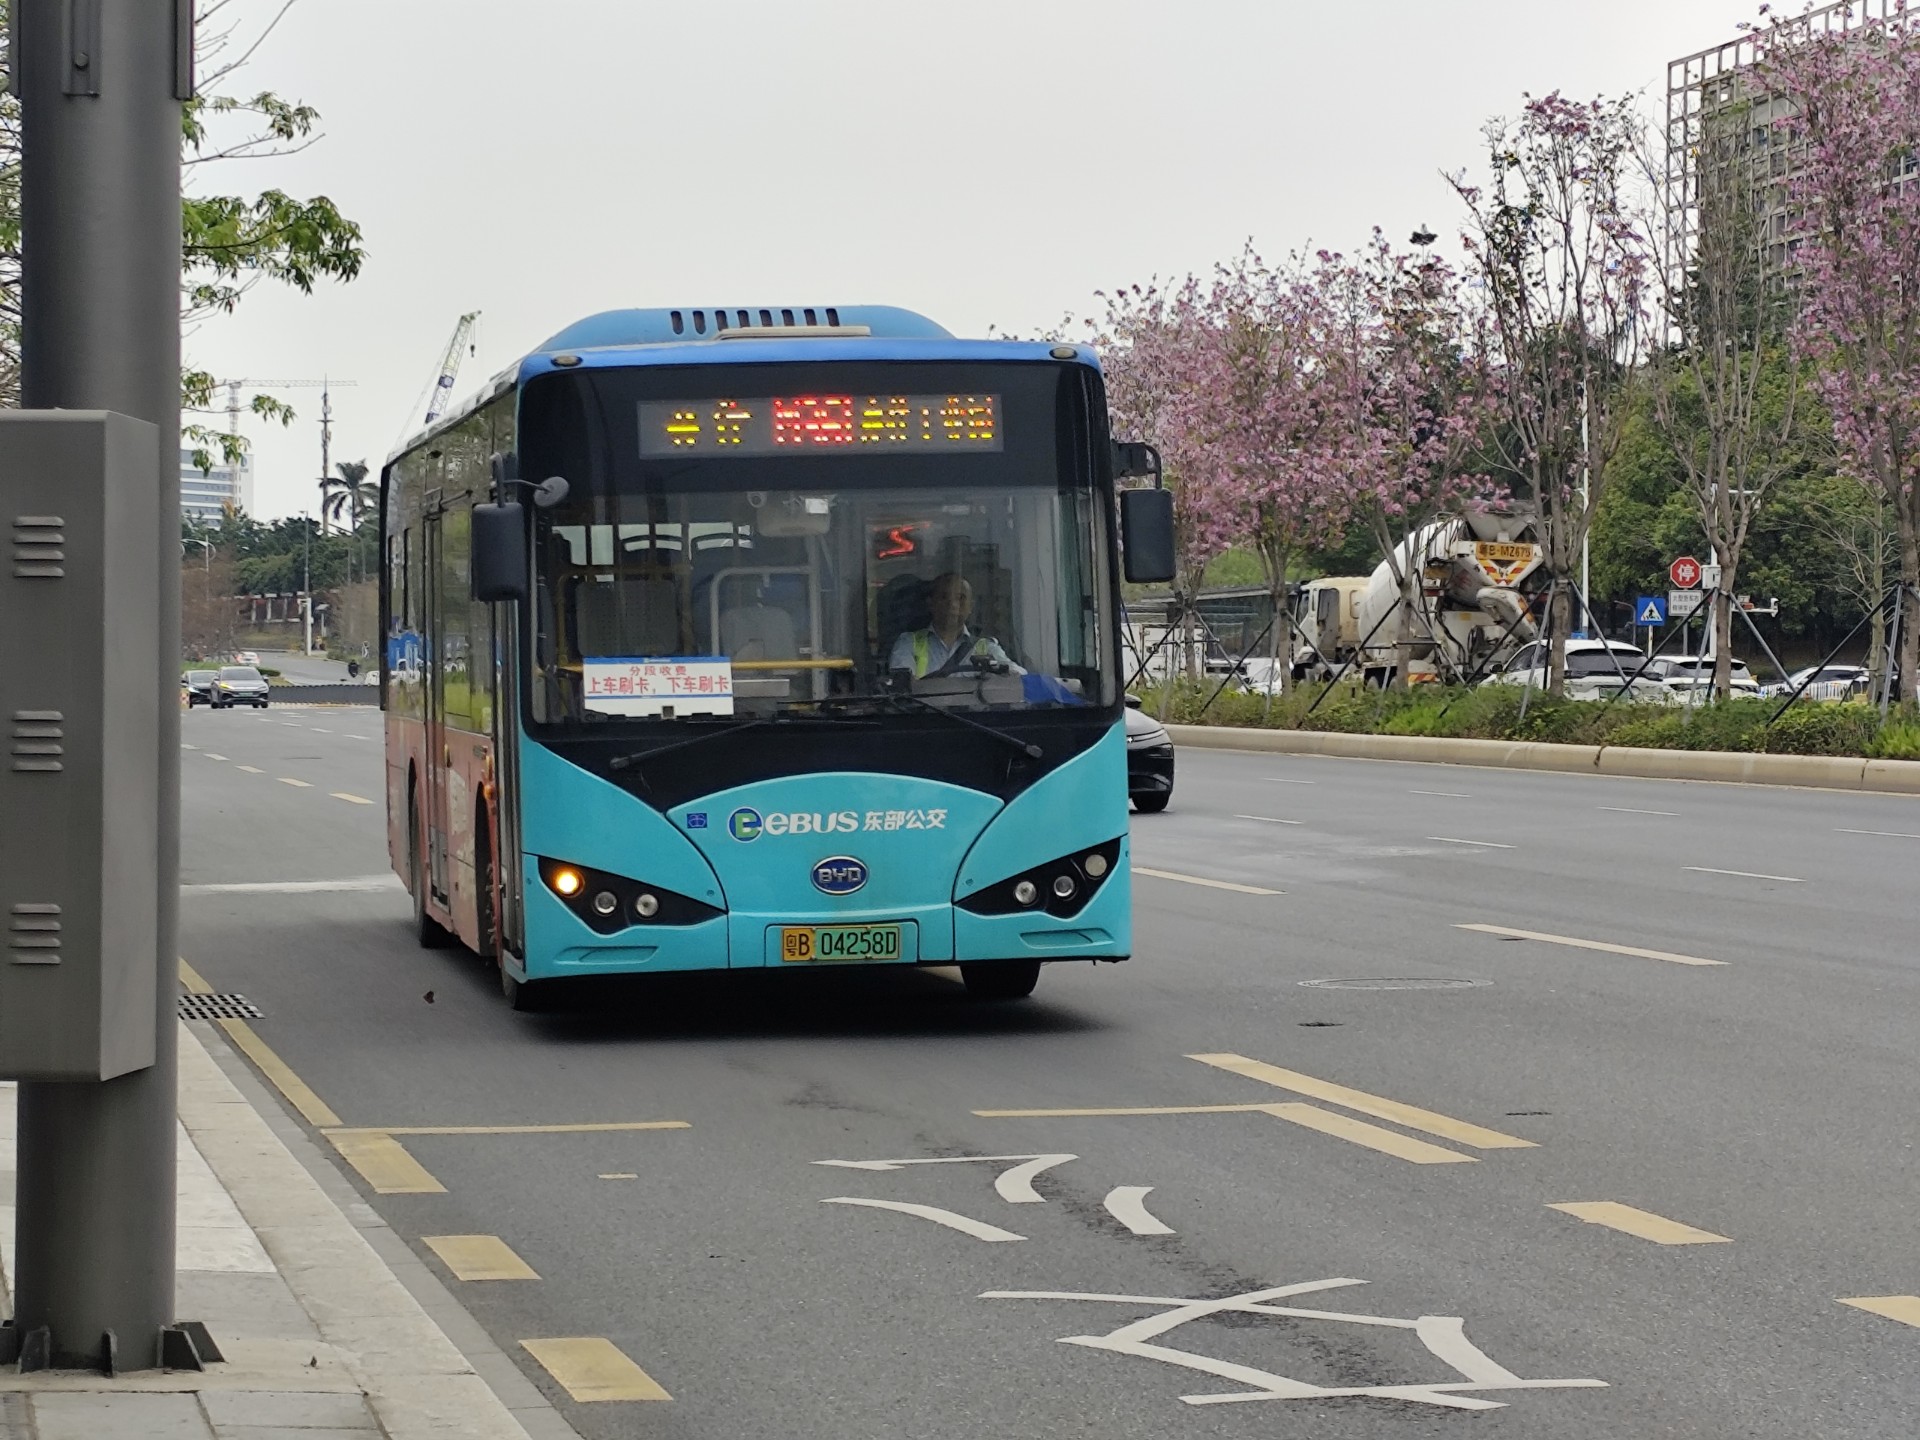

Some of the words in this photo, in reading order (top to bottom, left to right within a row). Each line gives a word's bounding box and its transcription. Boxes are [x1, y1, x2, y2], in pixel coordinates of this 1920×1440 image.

[1677, 564, 1695, 582] 停
[629, 665, 687, 676] 分段收费
[862, 808, 948, 832] 东部公交
[817, 867, 863, 884] BYD
